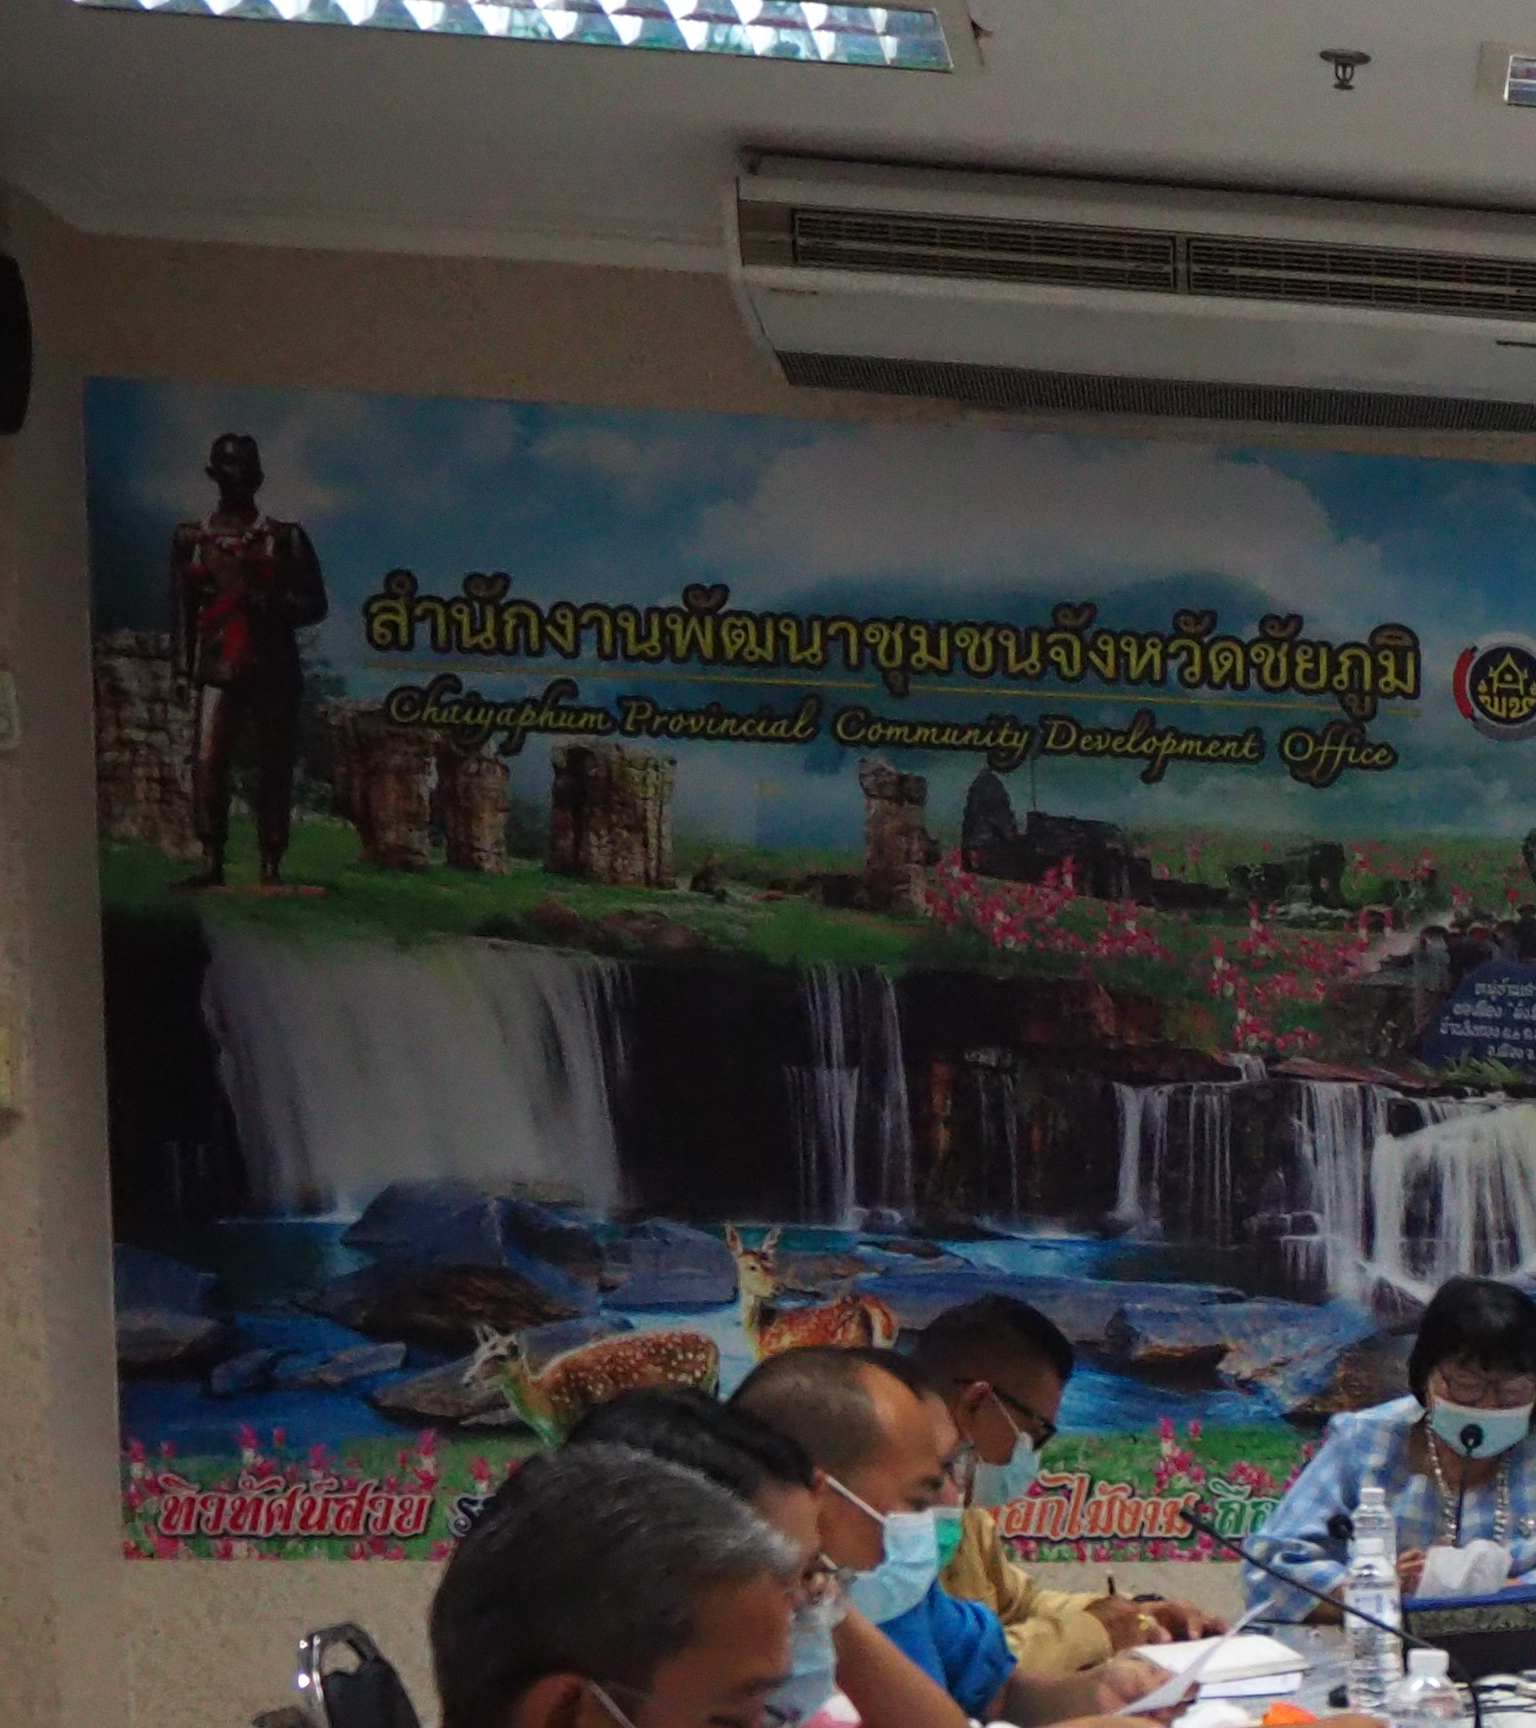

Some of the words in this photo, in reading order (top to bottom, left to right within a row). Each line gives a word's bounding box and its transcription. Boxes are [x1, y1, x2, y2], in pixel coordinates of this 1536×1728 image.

[364, 570, 1419, 720] สำนักงานพัฒนาชุมชนจังหวัดชัยภูมิ
[388, 675, 611, 755] Chaiyaphum
[621, 693, 820, 741] Provincial
[836, 706, 1032, 770] Community
[1043, 710, 1263, 783] Development
[1279, 718, 1397, 786] Office
[158, 1472, 435, 1539] ทิวทัศน์สวย
[990, 1470, 1201, 1540] อกไม้งาม
